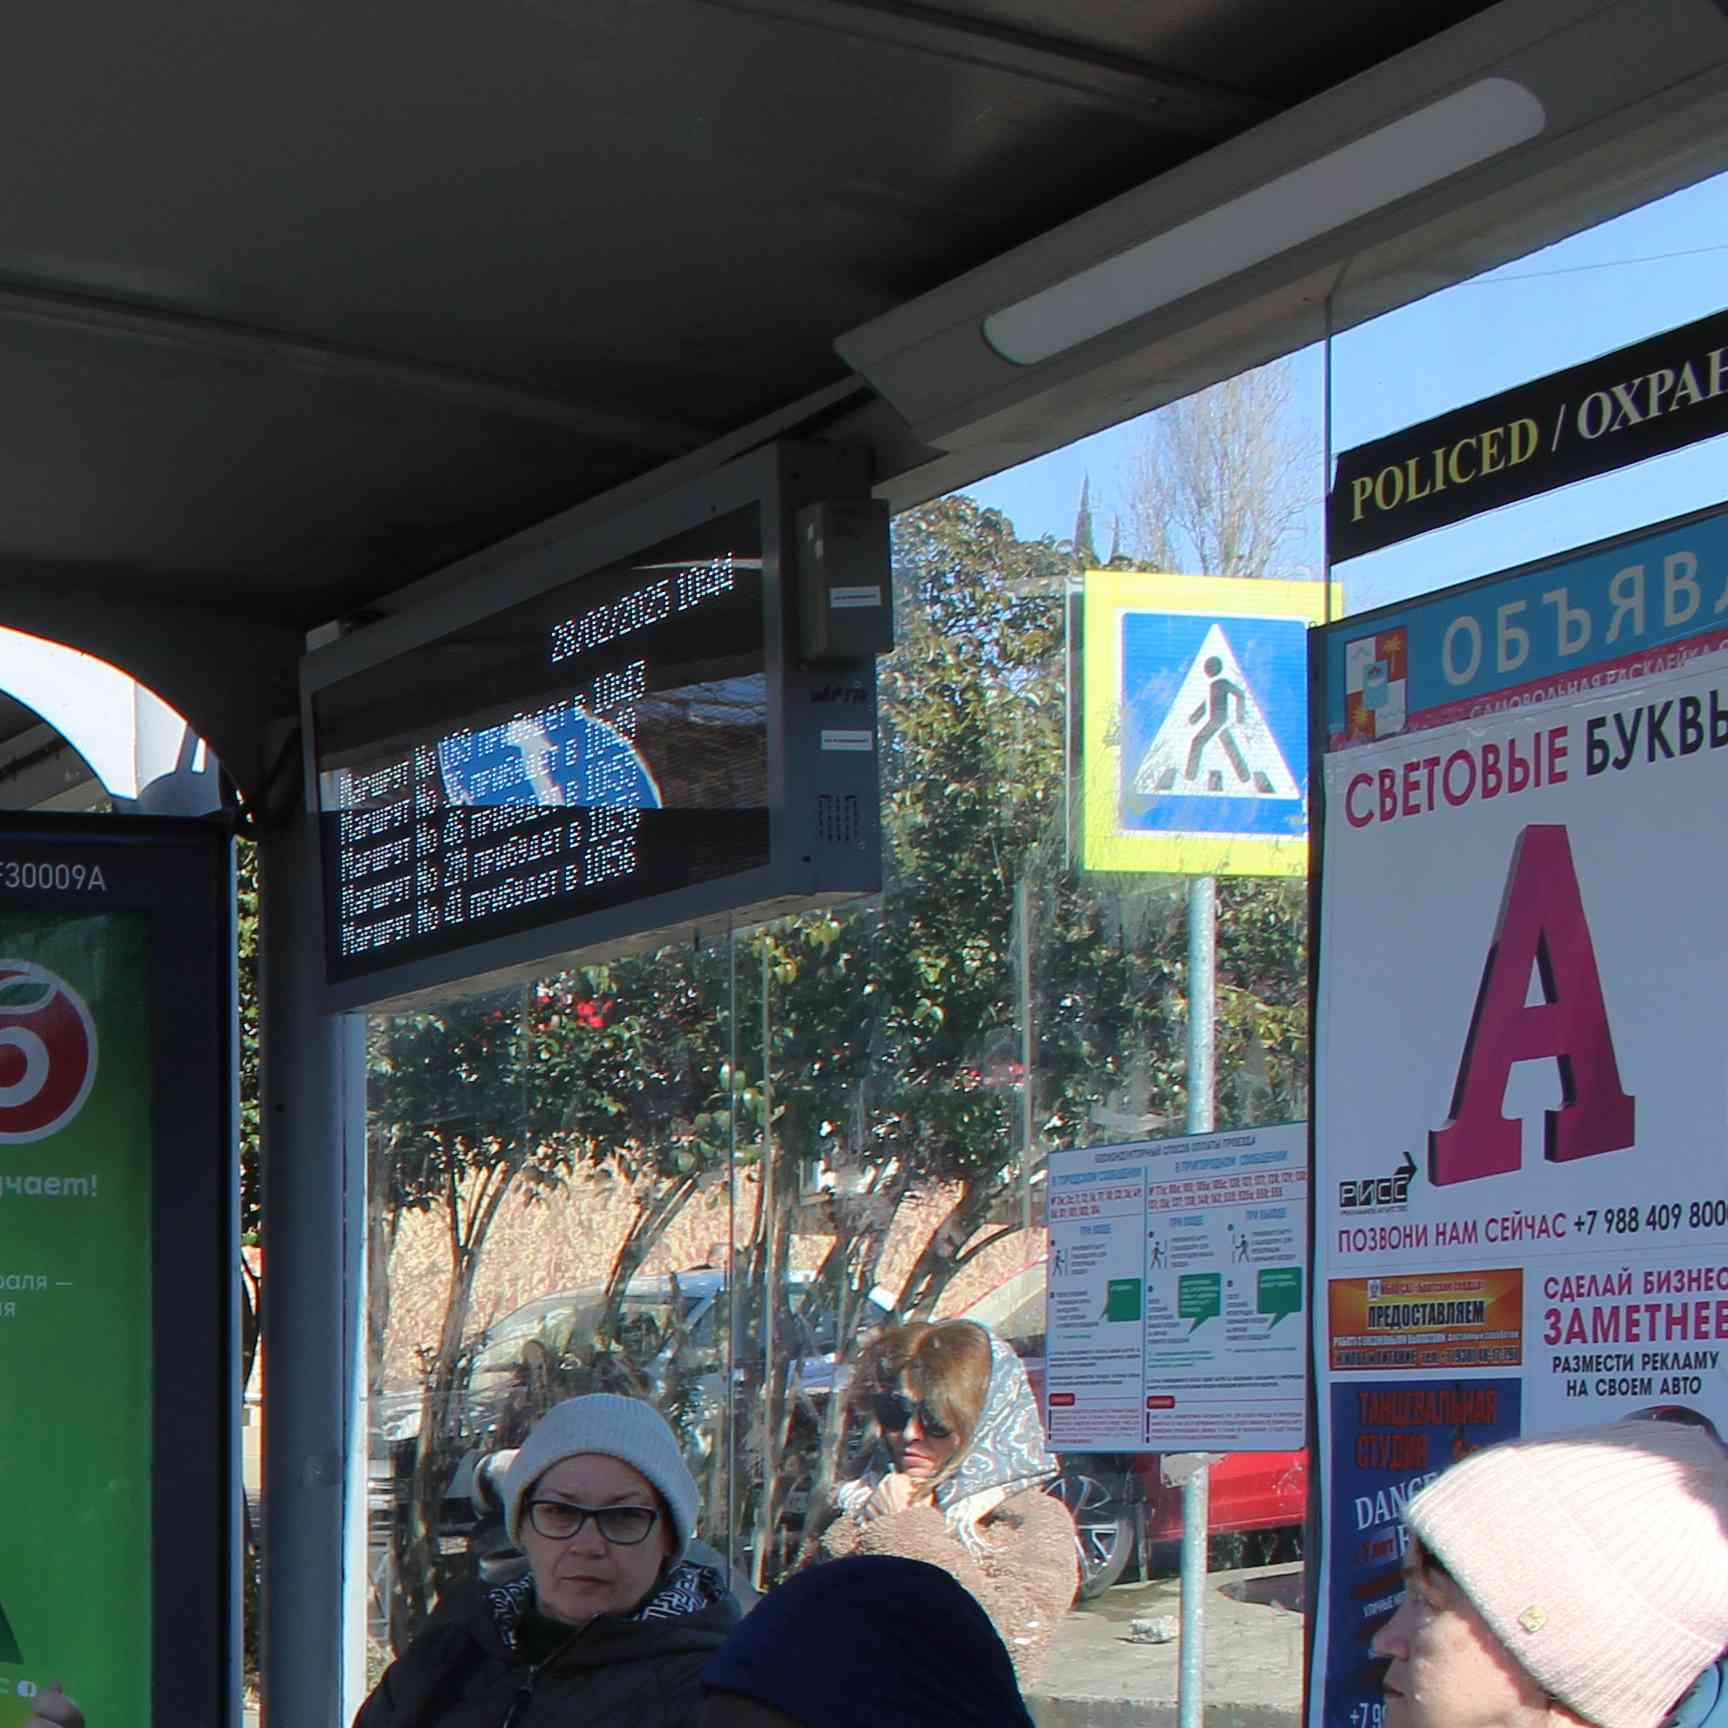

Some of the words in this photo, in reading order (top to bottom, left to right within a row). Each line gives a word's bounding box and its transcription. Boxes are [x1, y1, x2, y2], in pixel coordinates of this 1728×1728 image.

[1351, 418, 1539, 522] POLICED
[1443, 549, 1728, 686] ОБЪЯВ
[1345, 726, 1568, 828] СВЕТОВЫЕ
[1338, 1223, 1429, 1253] ПОЗВОНИ
[1435, 1219, 1479, 1247] НАМ
[1484, 1210, 1567, 1242] СЕЙЧАС
[1573, 1209, 1598, 1235] +7
[1604, 1206, 1640, 1233] 988
[1645, 1204, 1682, 1231] 409
[1688, 1200, 1728, 1228] 800
[1543, 1267, 1633, 1301] СДЕЛАЙ
[1368, 1301, 1485, 1329] ПРЕДОСТАВЛЯЕМ
[1543, 1301, 1728, 1345] ЗАМЕТНЕЕ
[1551, 1354, 1635, 1374] РАЗМЕСТИ
[1640, 1351, 1720, 1372] РЕКЛАМУ
[1566, 1378, 1589, 1398] НА
[1595, 1377, 1653, 1397] СВОЕМ
[1659, 1375, 1702, 1396] АВТО
